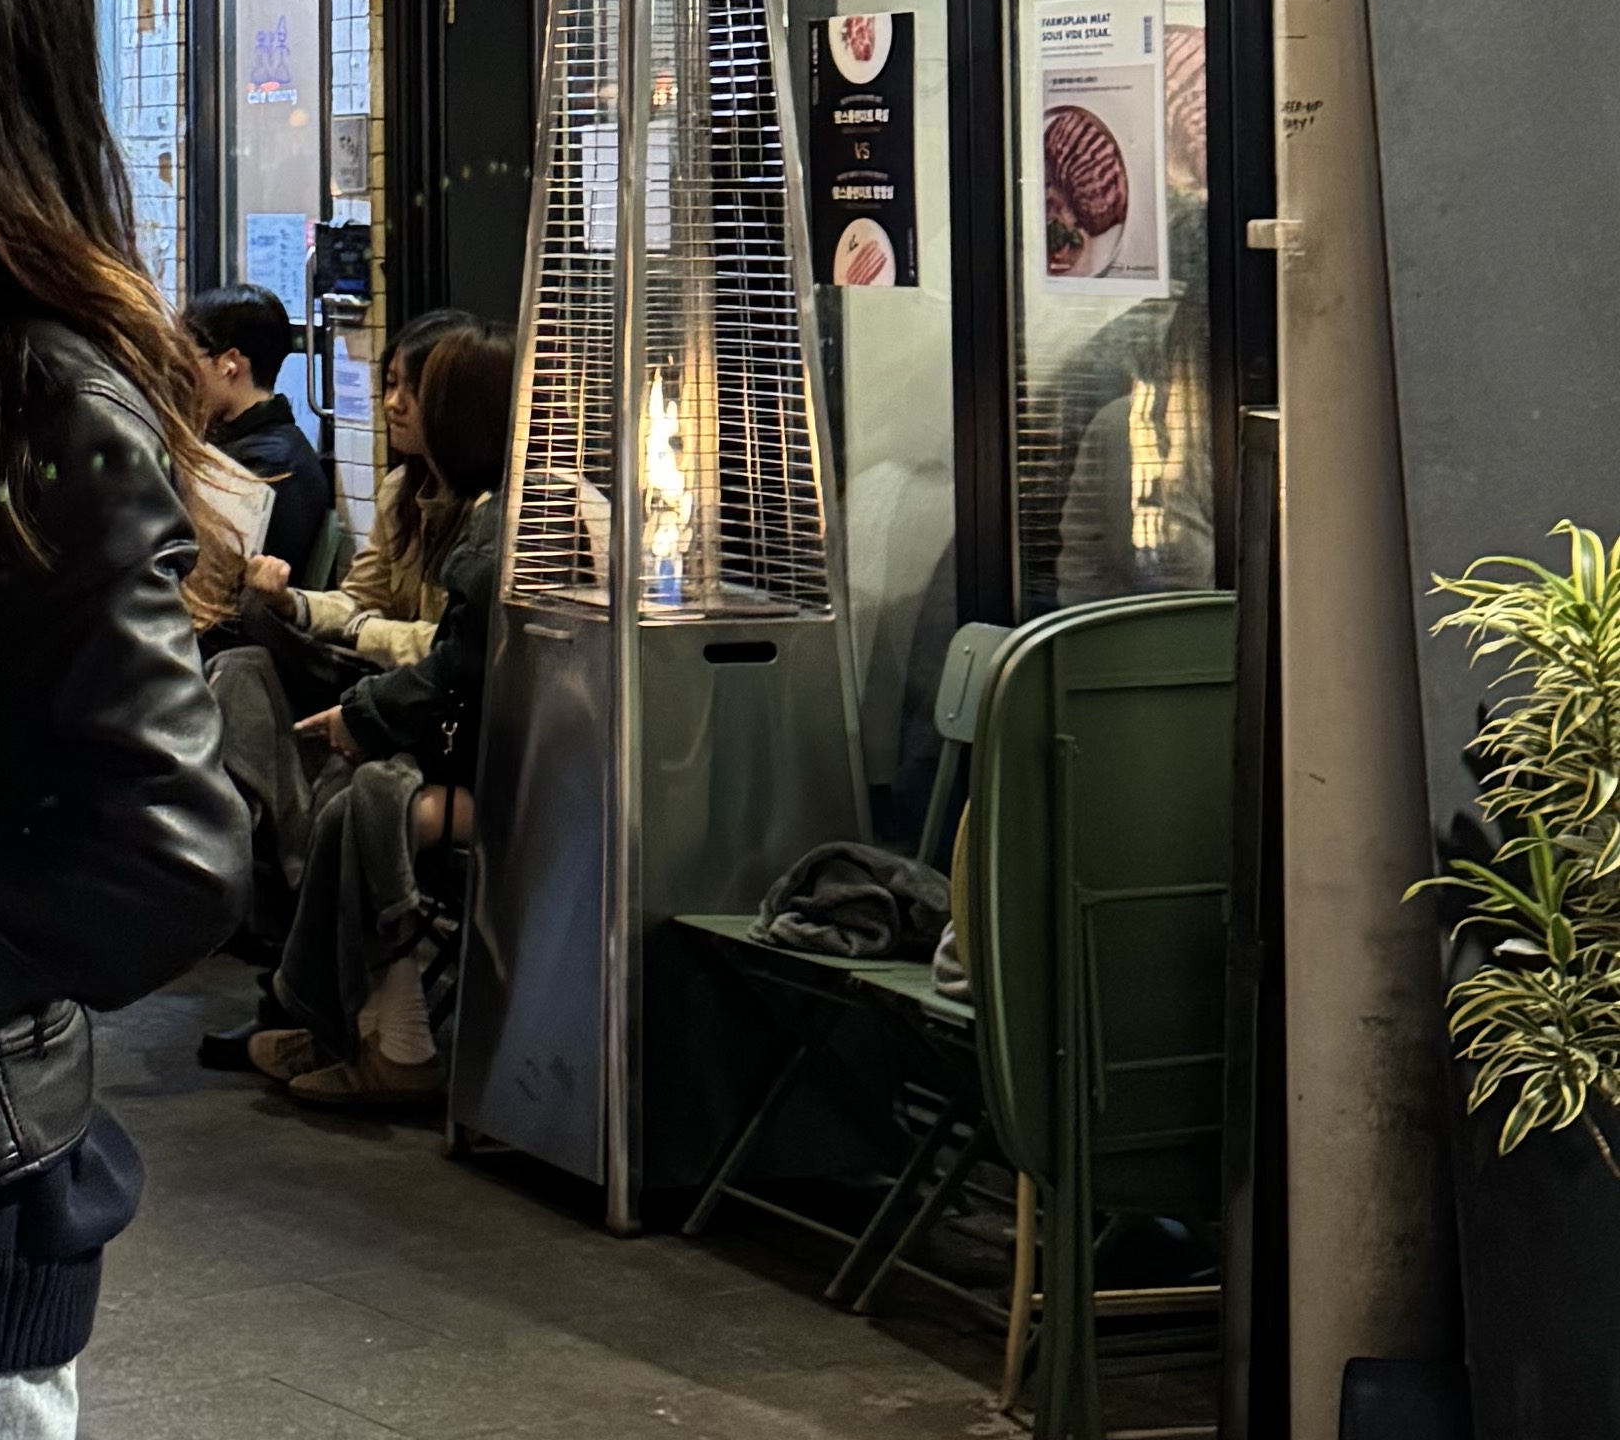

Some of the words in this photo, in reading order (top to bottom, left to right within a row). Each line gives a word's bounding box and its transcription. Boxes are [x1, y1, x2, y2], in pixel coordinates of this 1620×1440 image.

[1090, 12, 1111, 25] MEAT
[1042, 30, 1063, 42] SOUS
[854, 142, 871, 160] VS
